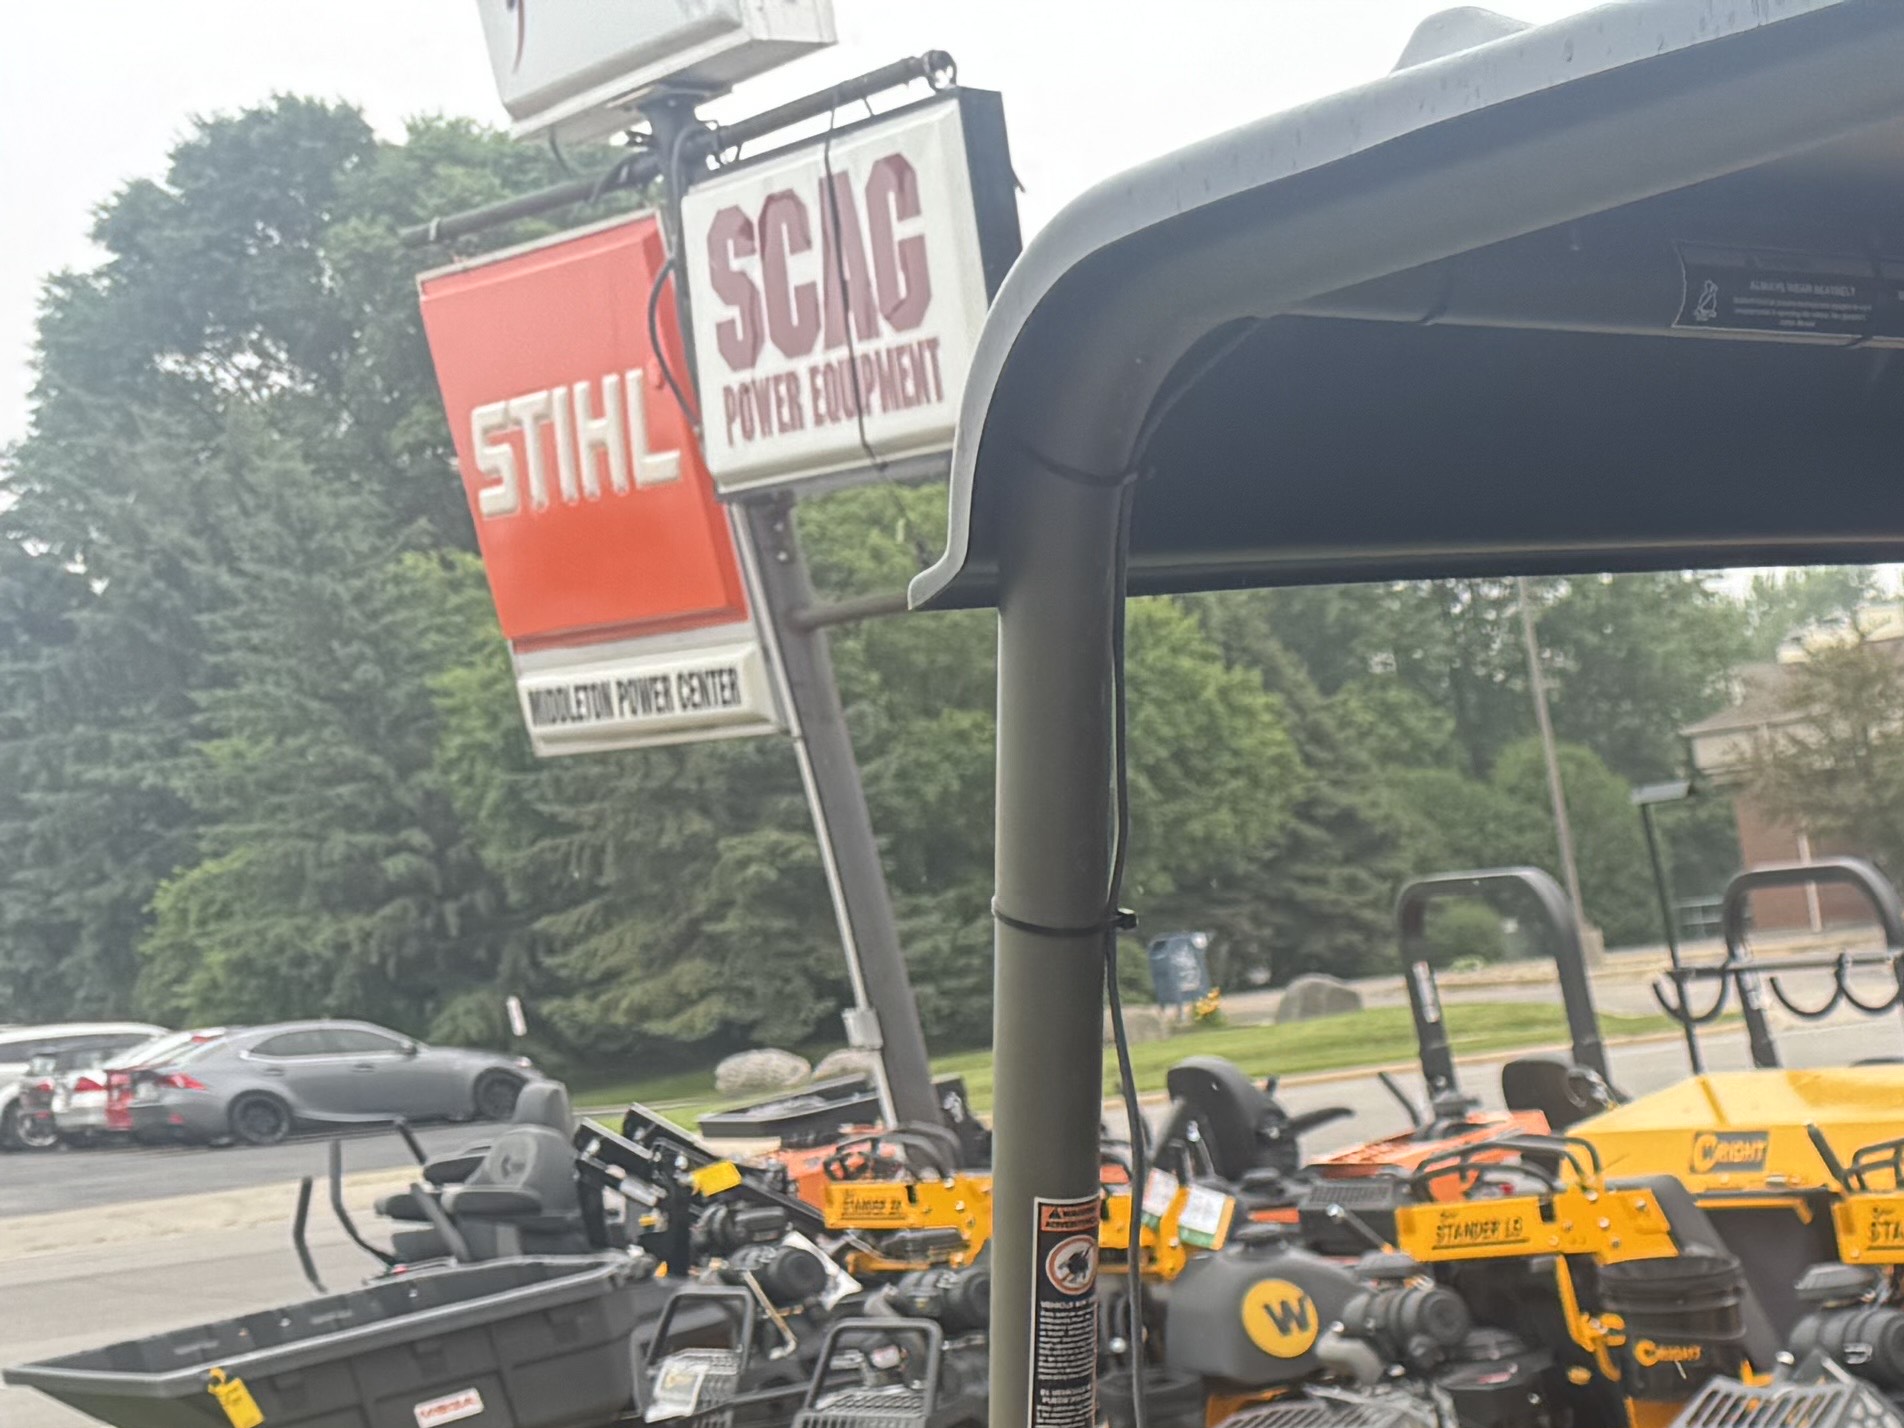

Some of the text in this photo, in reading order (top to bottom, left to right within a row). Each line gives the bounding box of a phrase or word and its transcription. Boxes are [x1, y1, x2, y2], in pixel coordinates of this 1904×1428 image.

[707, 153, 932, 372] SCAG
[722, 336, 944, 448] POWER EQUIPMENT
[470, 369, 681, 519] STIHL
[528, 666, 743, 727] MIDDLETON POWER CENTER
[1435, 1219, 1501, 1243] STANDER
[1262, 1294, 1312, 1339] W
